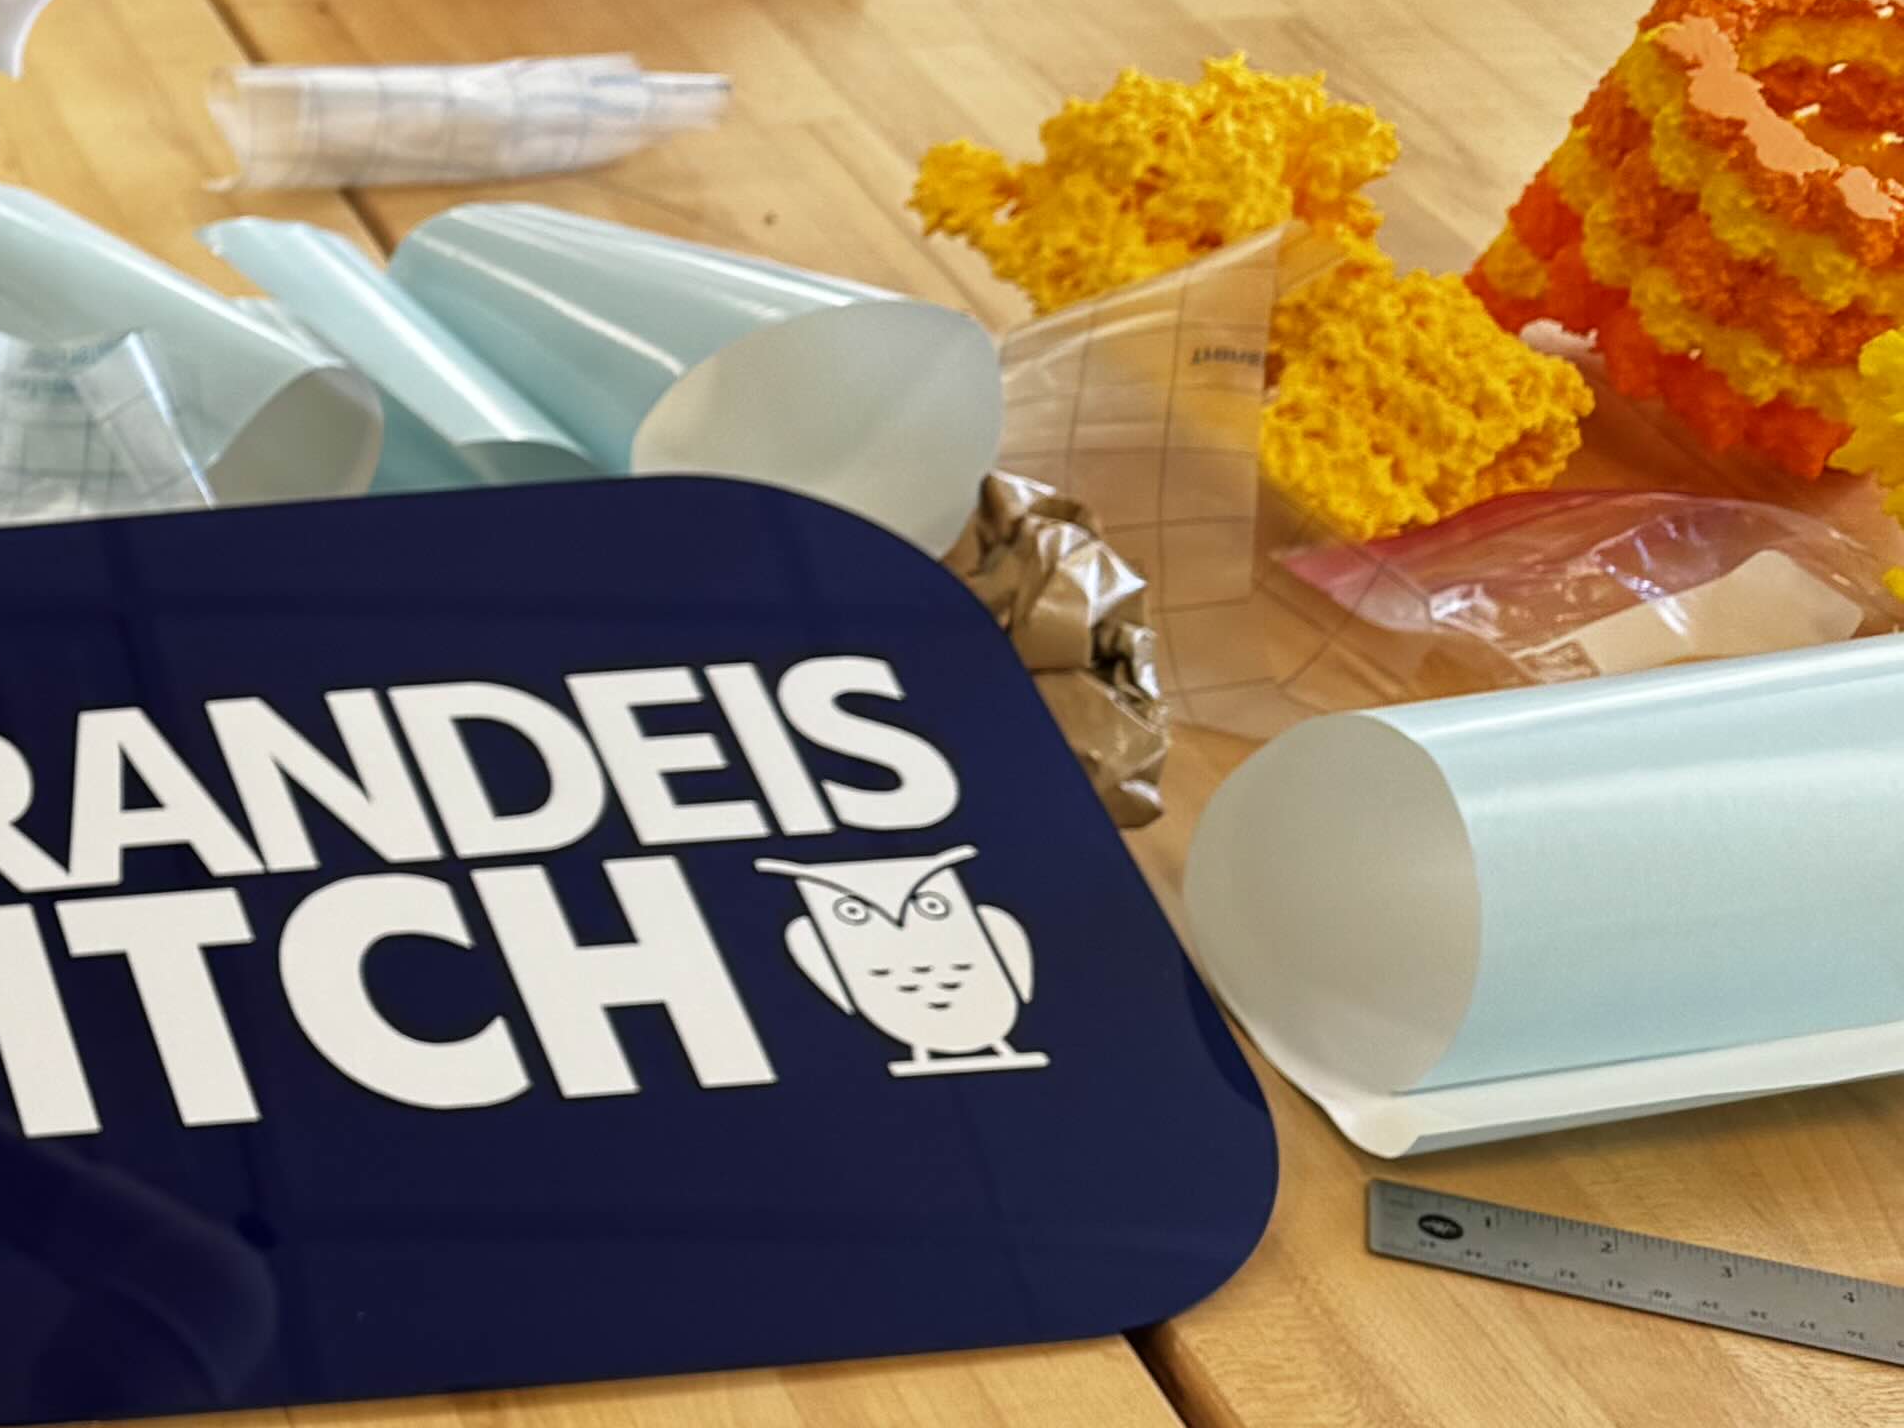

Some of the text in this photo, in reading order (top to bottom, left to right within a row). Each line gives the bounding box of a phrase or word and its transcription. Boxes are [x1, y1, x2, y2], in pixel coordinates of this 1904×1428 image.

[1600, 1241, 1613, 1253] 2
[1721, 1266, 1733, 1278] 3
[1843, 1291, 1855, 1304] 4
